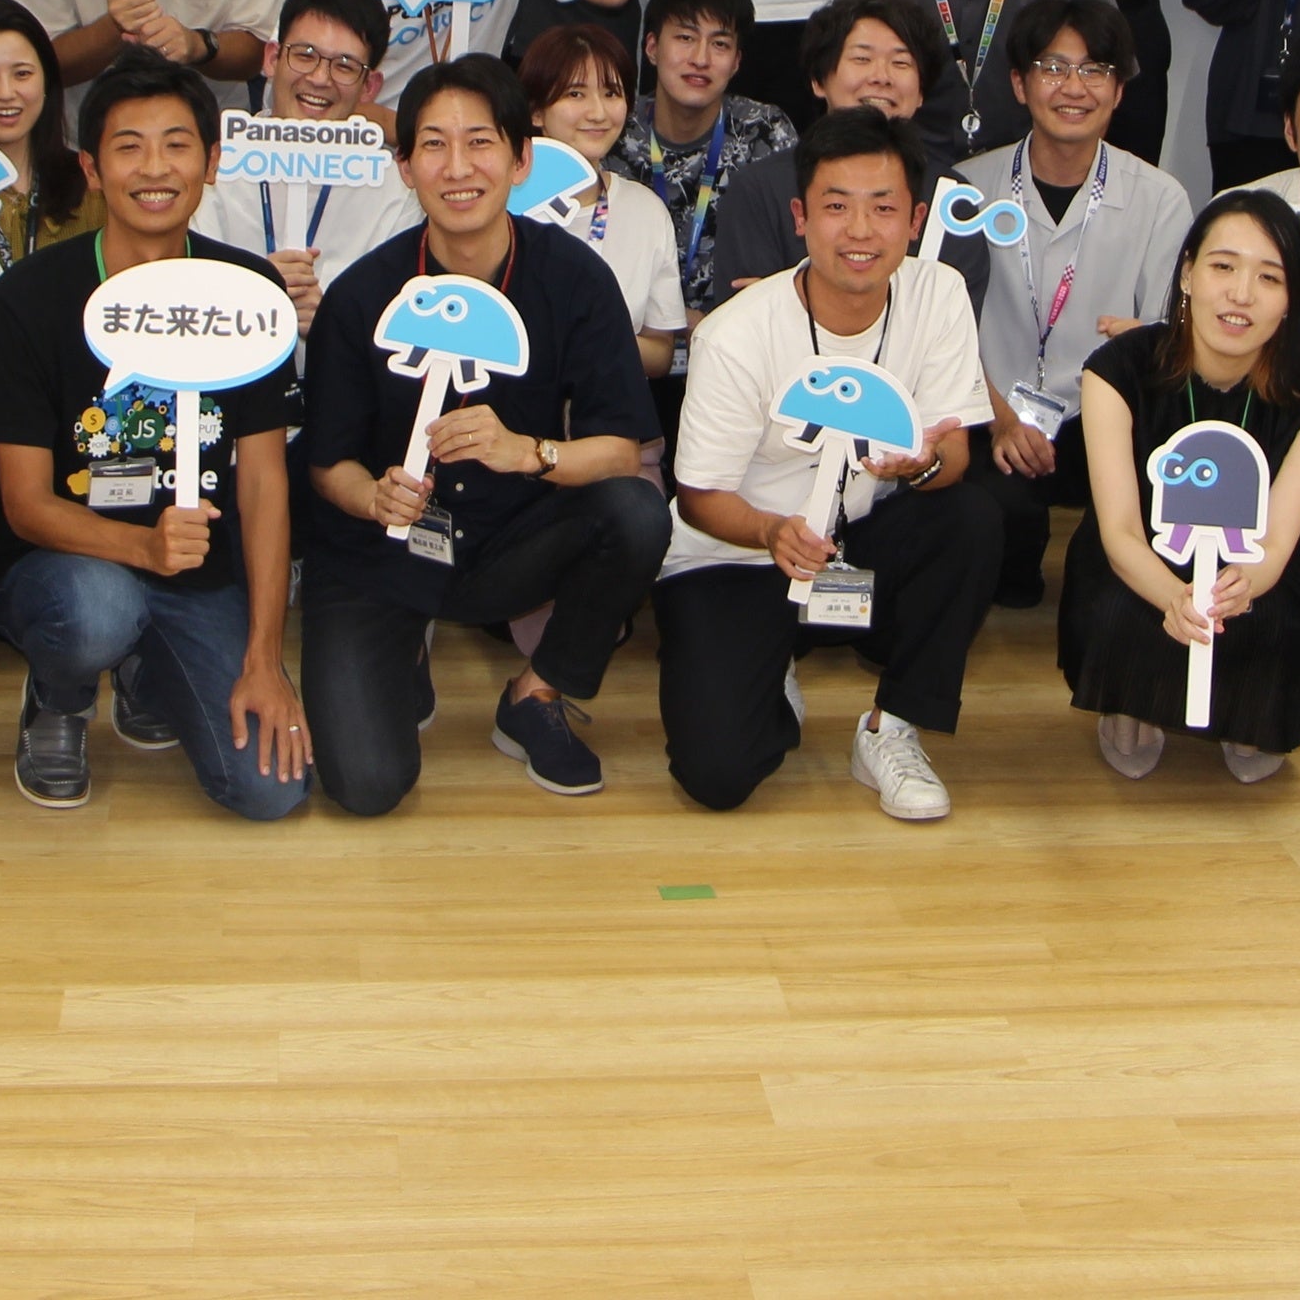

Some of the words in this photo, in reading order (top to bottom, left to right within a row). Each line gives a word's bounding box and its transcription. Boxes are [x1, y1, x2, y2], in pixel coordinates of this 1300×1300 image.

[227, 117, 377, 145] Panasonic
[218, 145, 386, 180] CONNECT
[102, 302, 278, 337] また来たい!
[132, 419, 156, 439] JS
